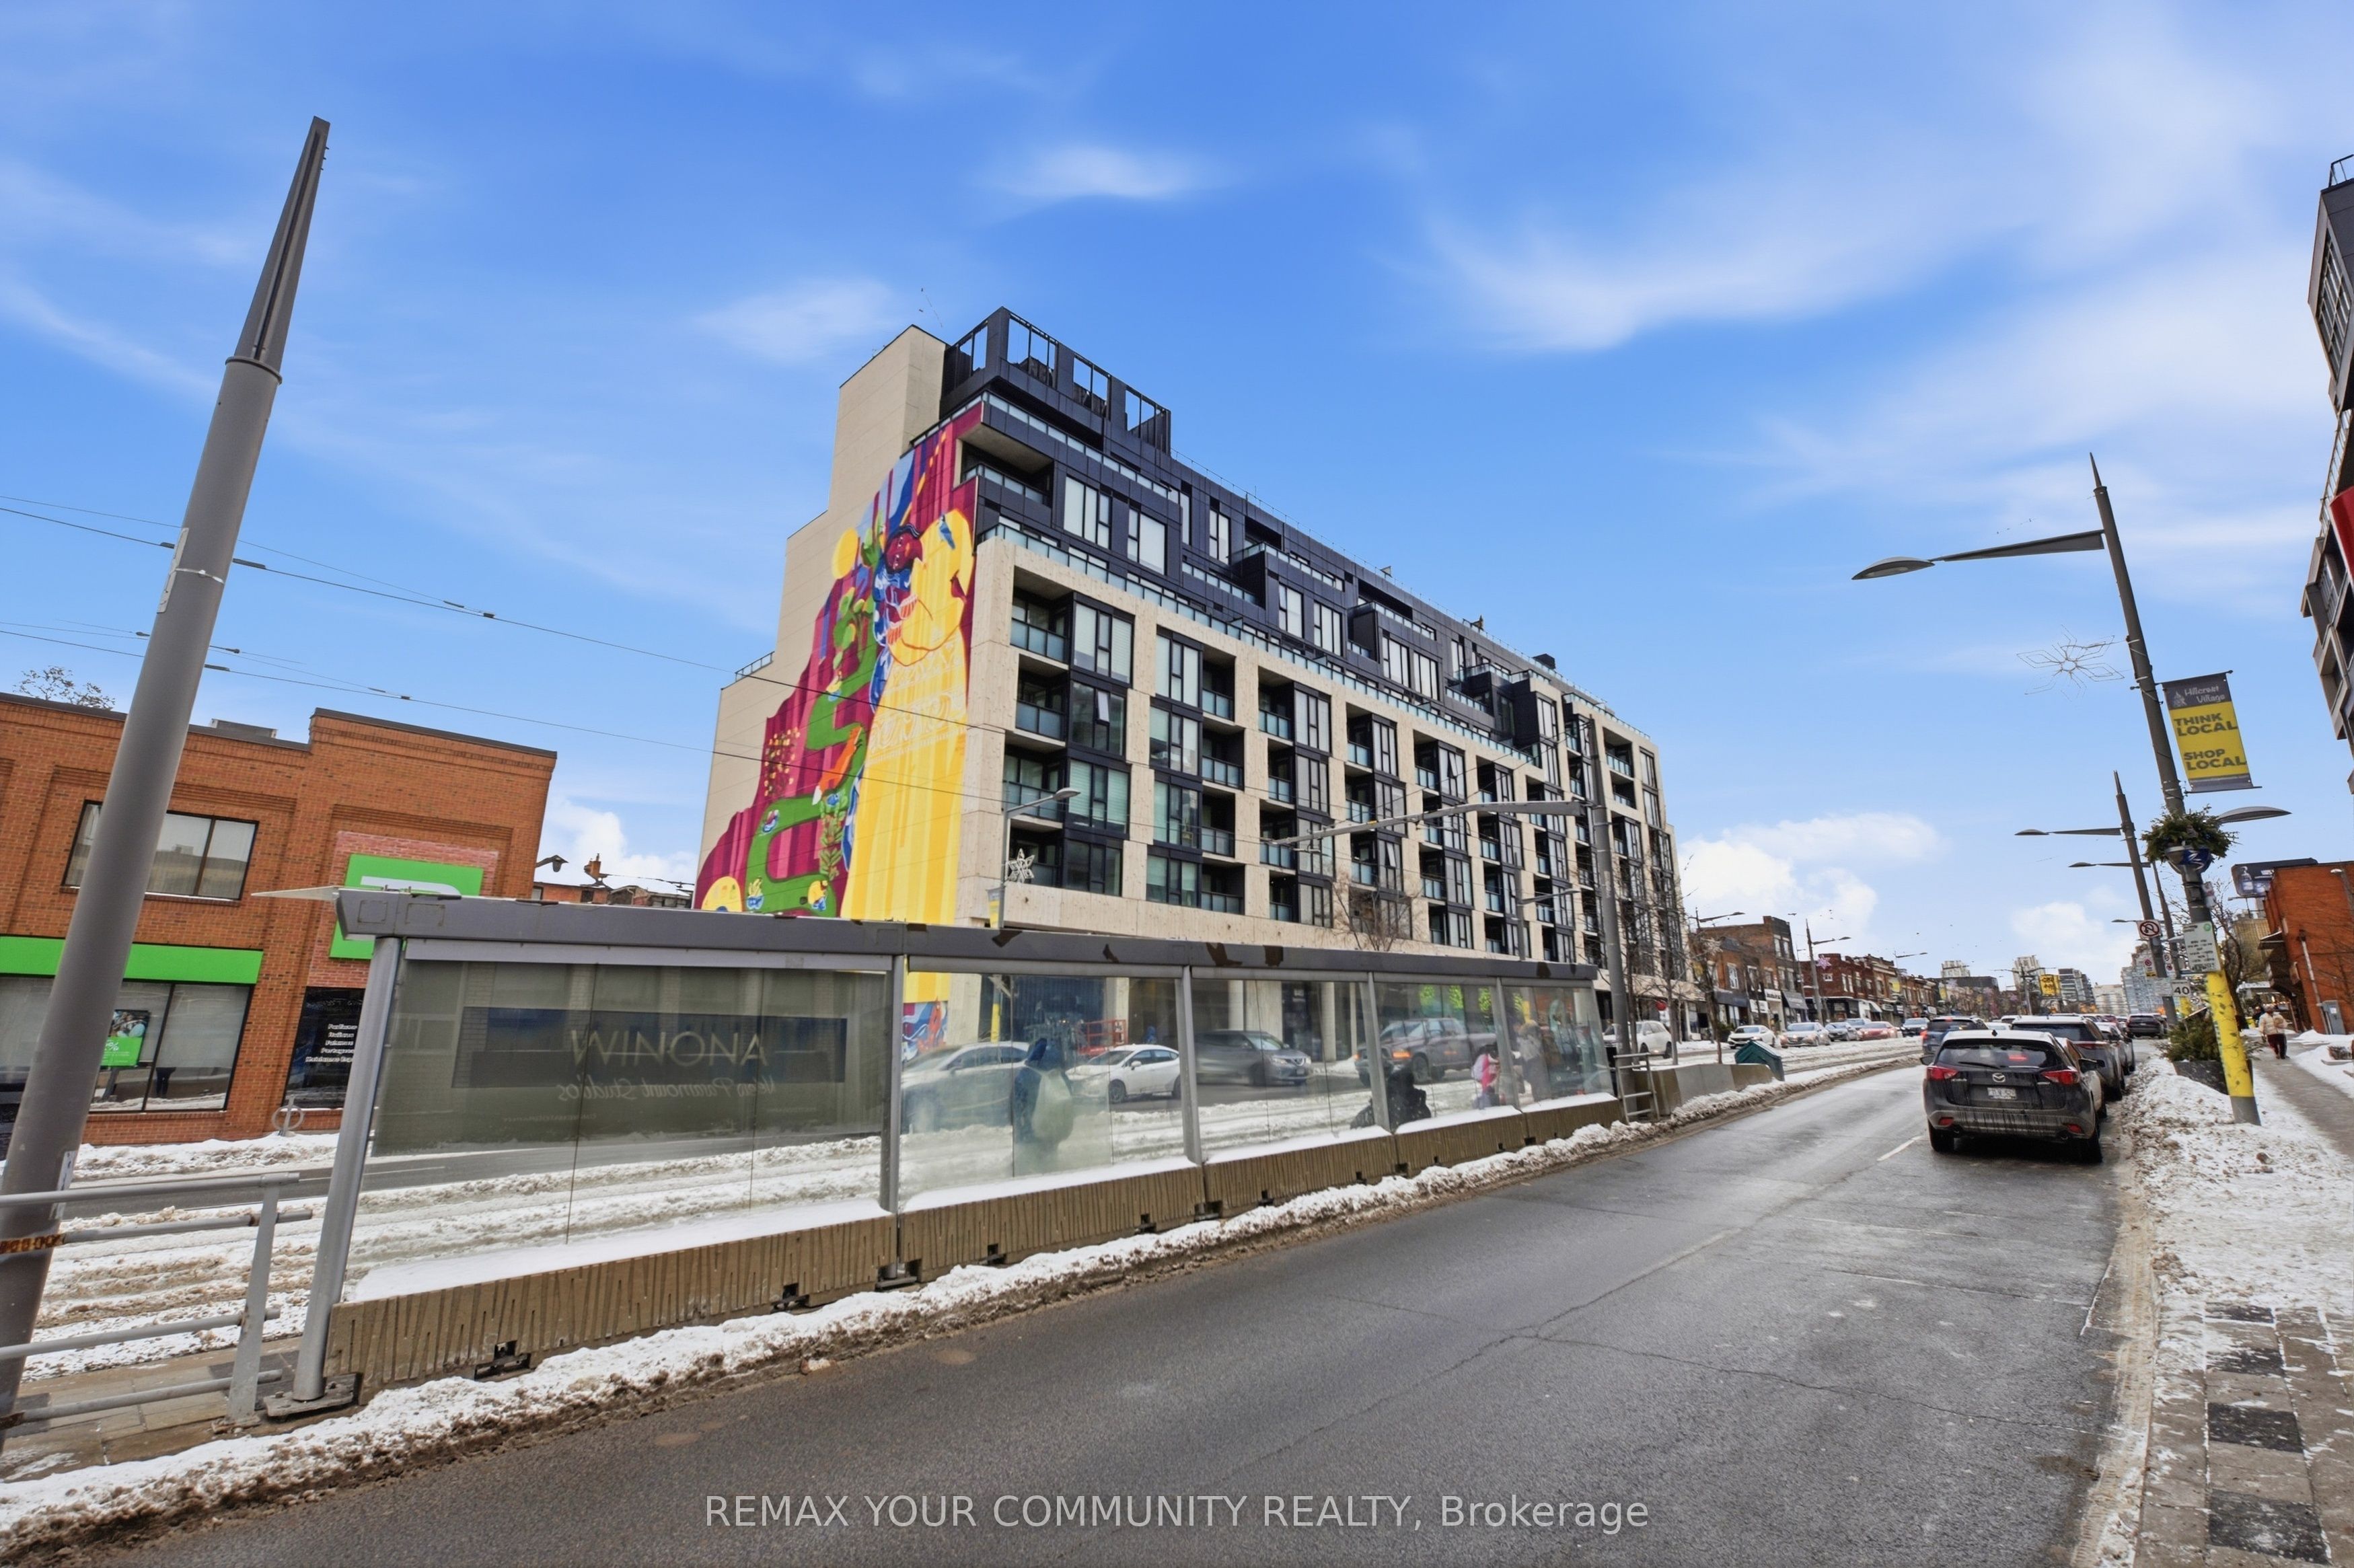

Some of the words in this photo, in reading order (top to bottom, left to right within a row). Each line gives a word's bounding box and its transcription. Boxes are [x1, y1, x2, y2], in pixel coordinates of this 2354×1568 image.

[2196, 694, 2226, 704] Village
[2174, 713, 2223, 726] THINK
[2176, 721, 2238, 737] LOCAL
[2184, 749, 2226, 761] SHOP
[2186, 756, 2246, 771] LOCAL
[2174, 986, 2190, 995] 40
[571, 1030, 770, 1068] WINONA
